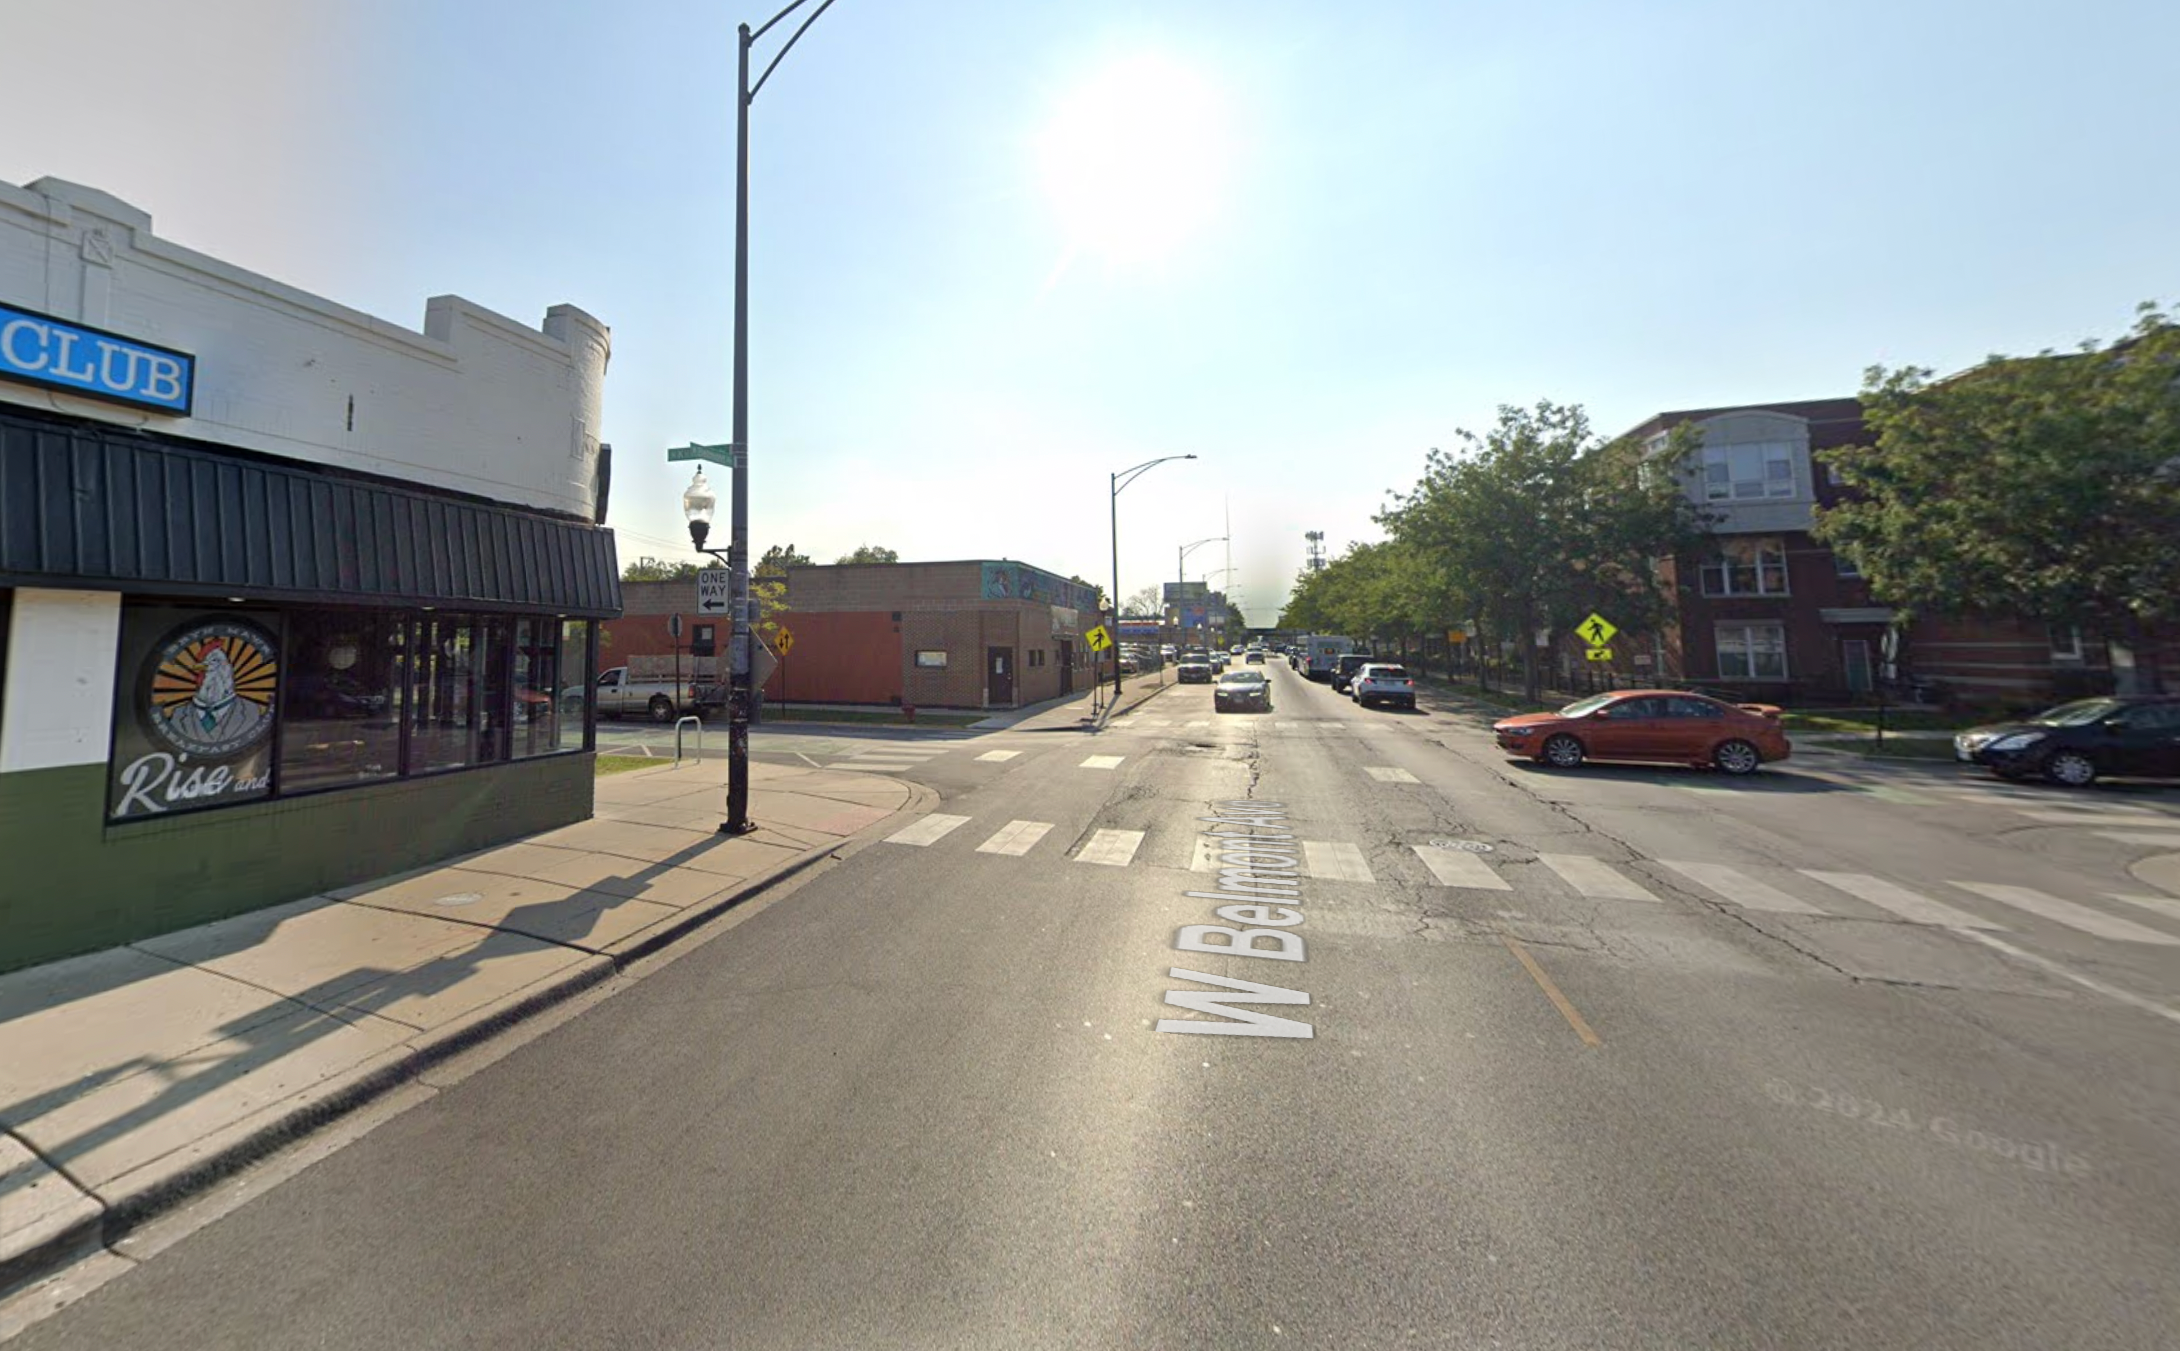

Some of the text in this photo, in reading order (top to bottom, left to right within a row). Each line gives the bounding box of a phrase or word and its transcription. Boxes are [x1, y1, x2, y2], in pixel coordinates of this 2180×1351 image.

[1, 320, 181, 400] CLUB
[701, 572, 726, 584] ONE
[701, 585, 726, 597] WAY
[112, 752, 270, 817] Rise and
